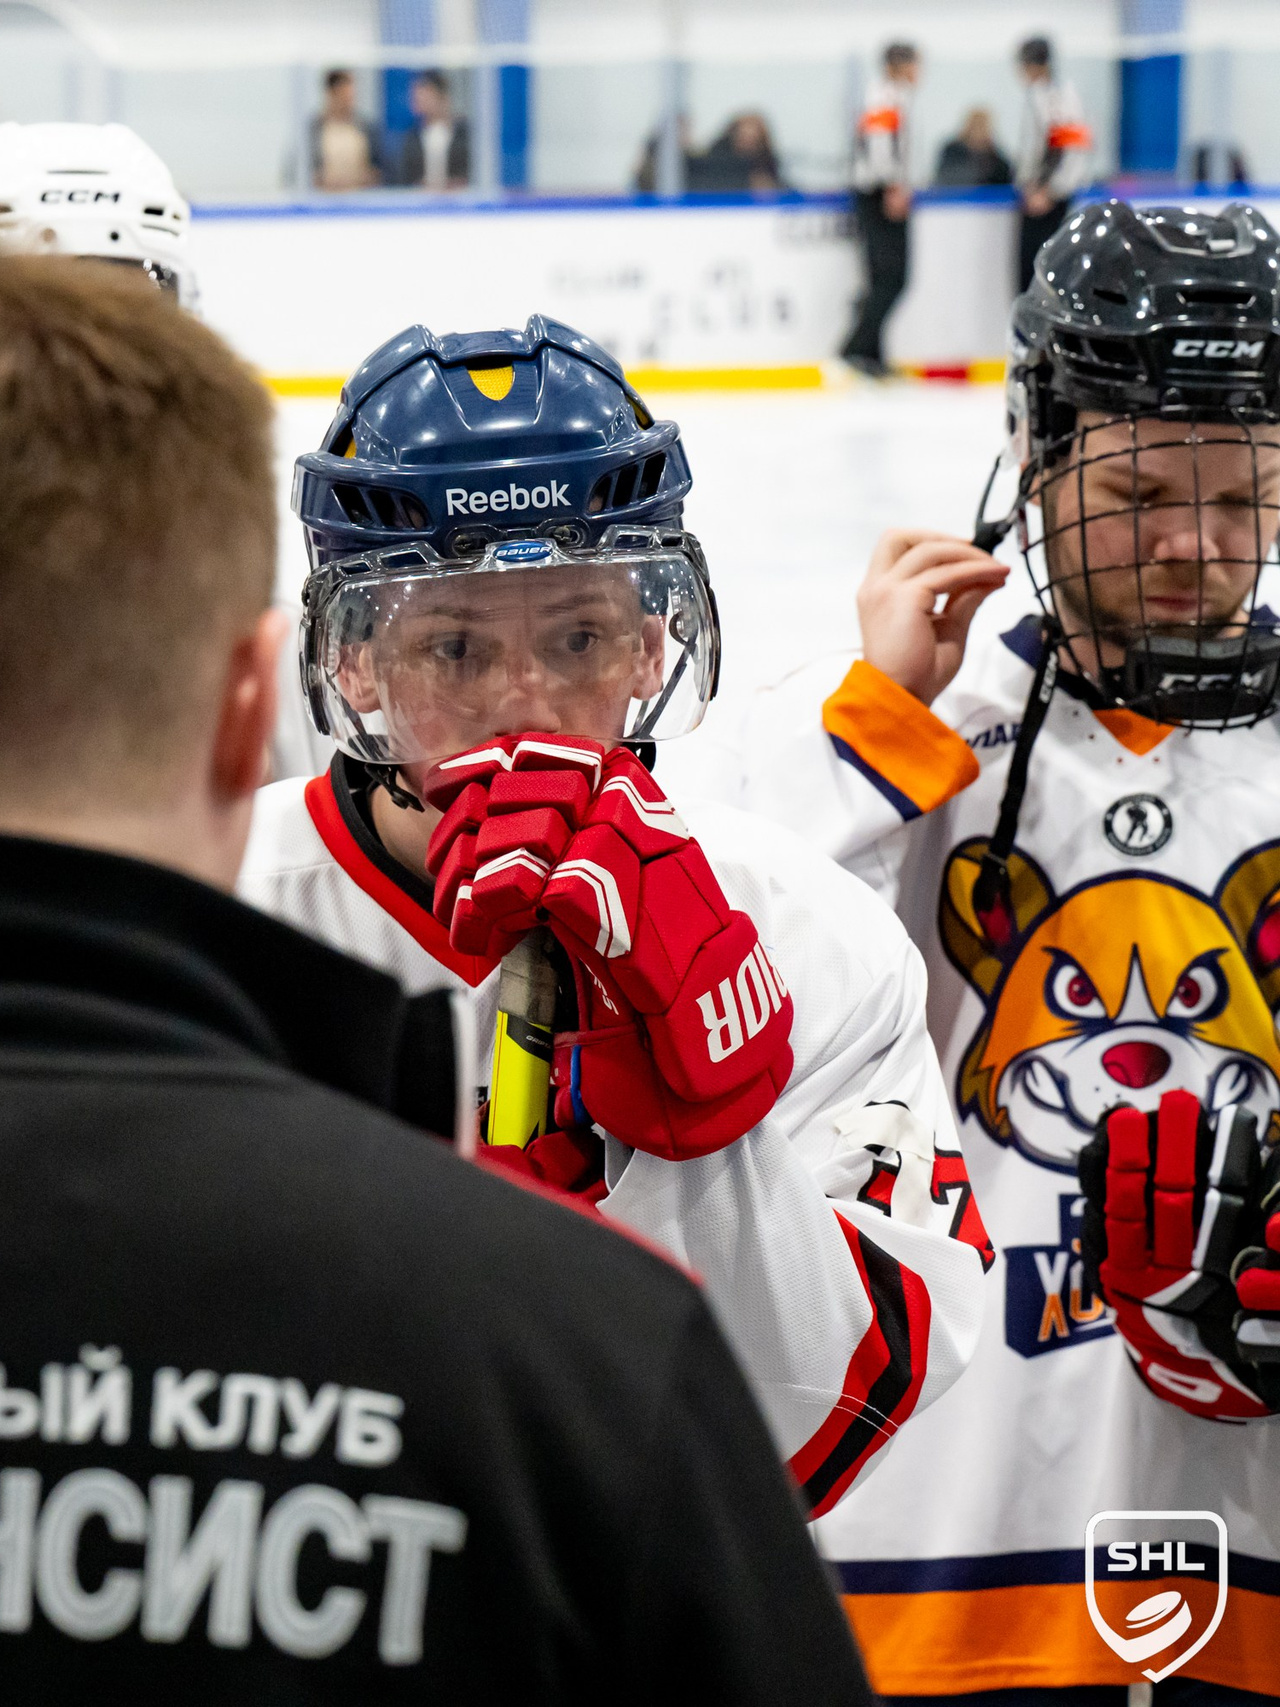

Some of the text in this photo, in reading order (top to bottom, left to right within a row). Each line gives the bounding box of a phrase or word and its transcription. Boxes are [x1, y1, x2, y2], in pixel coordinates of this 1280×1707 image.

[41, 189, 120, 203] CCM
[1172, 339, 1265, 358] CCM
[445, 480, 572, 516] Reebok
[495, 546, 552, 557] BAUER
[150, 1366, 404, 1466] КЛУБ
